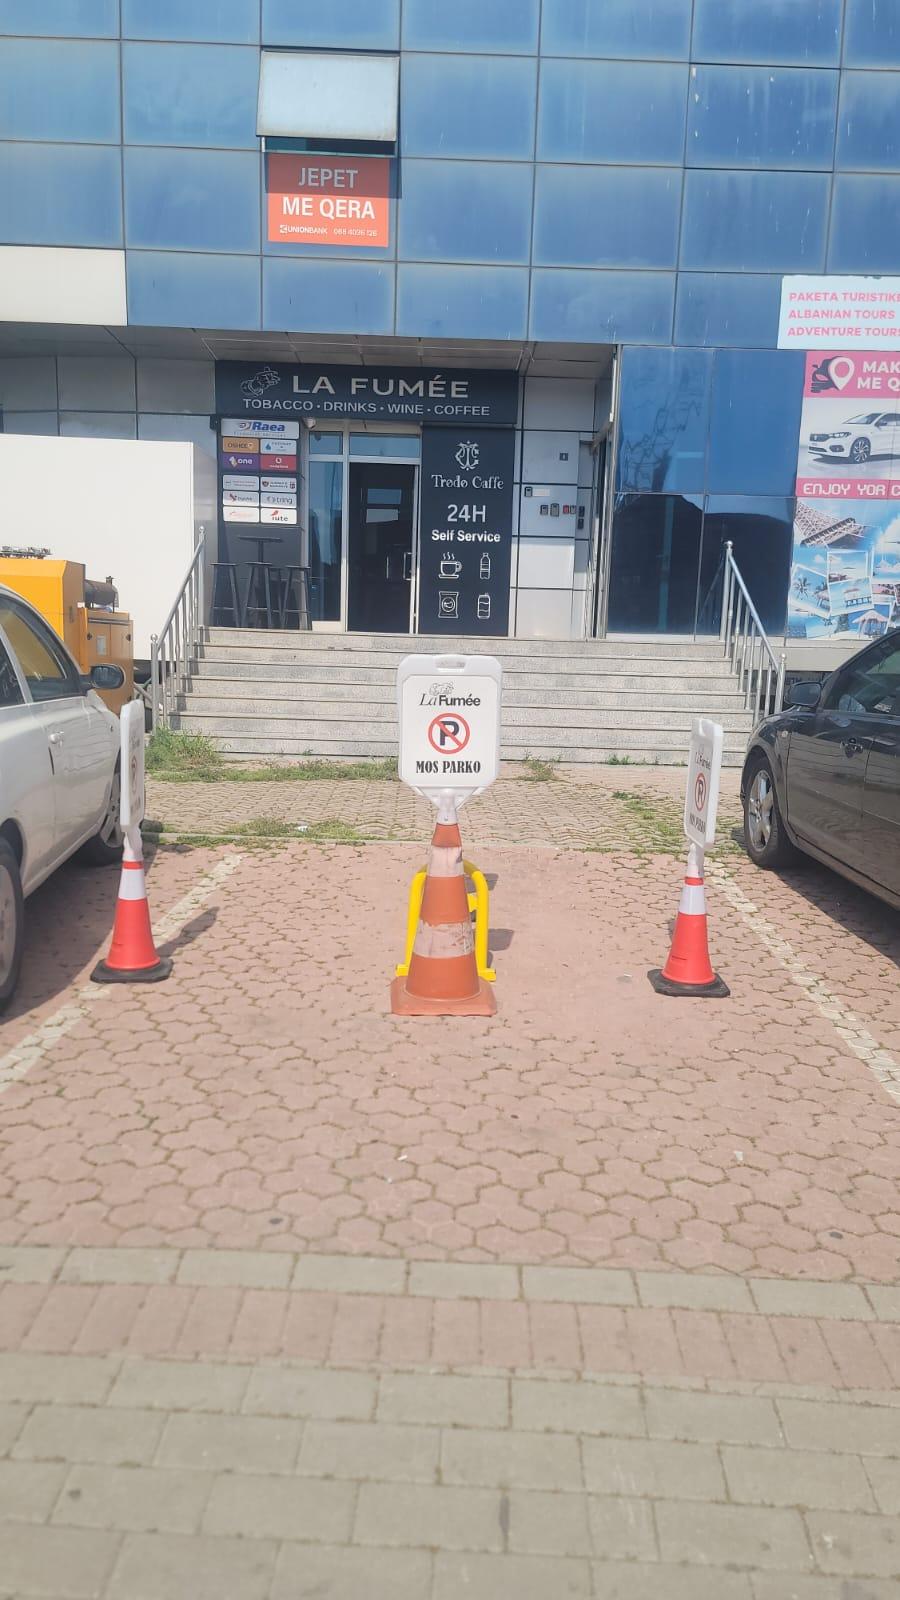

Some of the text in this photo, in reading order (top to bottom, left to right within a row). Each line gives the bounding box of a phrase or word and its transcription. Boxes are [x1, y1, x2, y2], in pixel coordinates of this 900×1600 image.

[298, 167, 359, 188] JEPET
[282, 197, 376, 220] ME QERA
[288, 226, 328, 235] UNIONBANK
[789, 292, 838, 302] PAKETA
[788, 310, 896, 320] ALBANIAN TOURS
[787, 327, 862, 337] ADVENTURE
[293, 374, 469, 399] LA FUMÉE
[857, 377, 882, 390] ME
[243, 399, 491, 416] TOBACCO DRINKS WINE COFFEE
[252, 421, 285, 432] Raea
[472, 475, 505, 490] Caffe
[803, 483, 850, 496] ENJOY
[447, 503, 487, 523] 24H
[431, 529, 501, 543] Self Service
[416, 760, 481, 774] MOS PARKO
